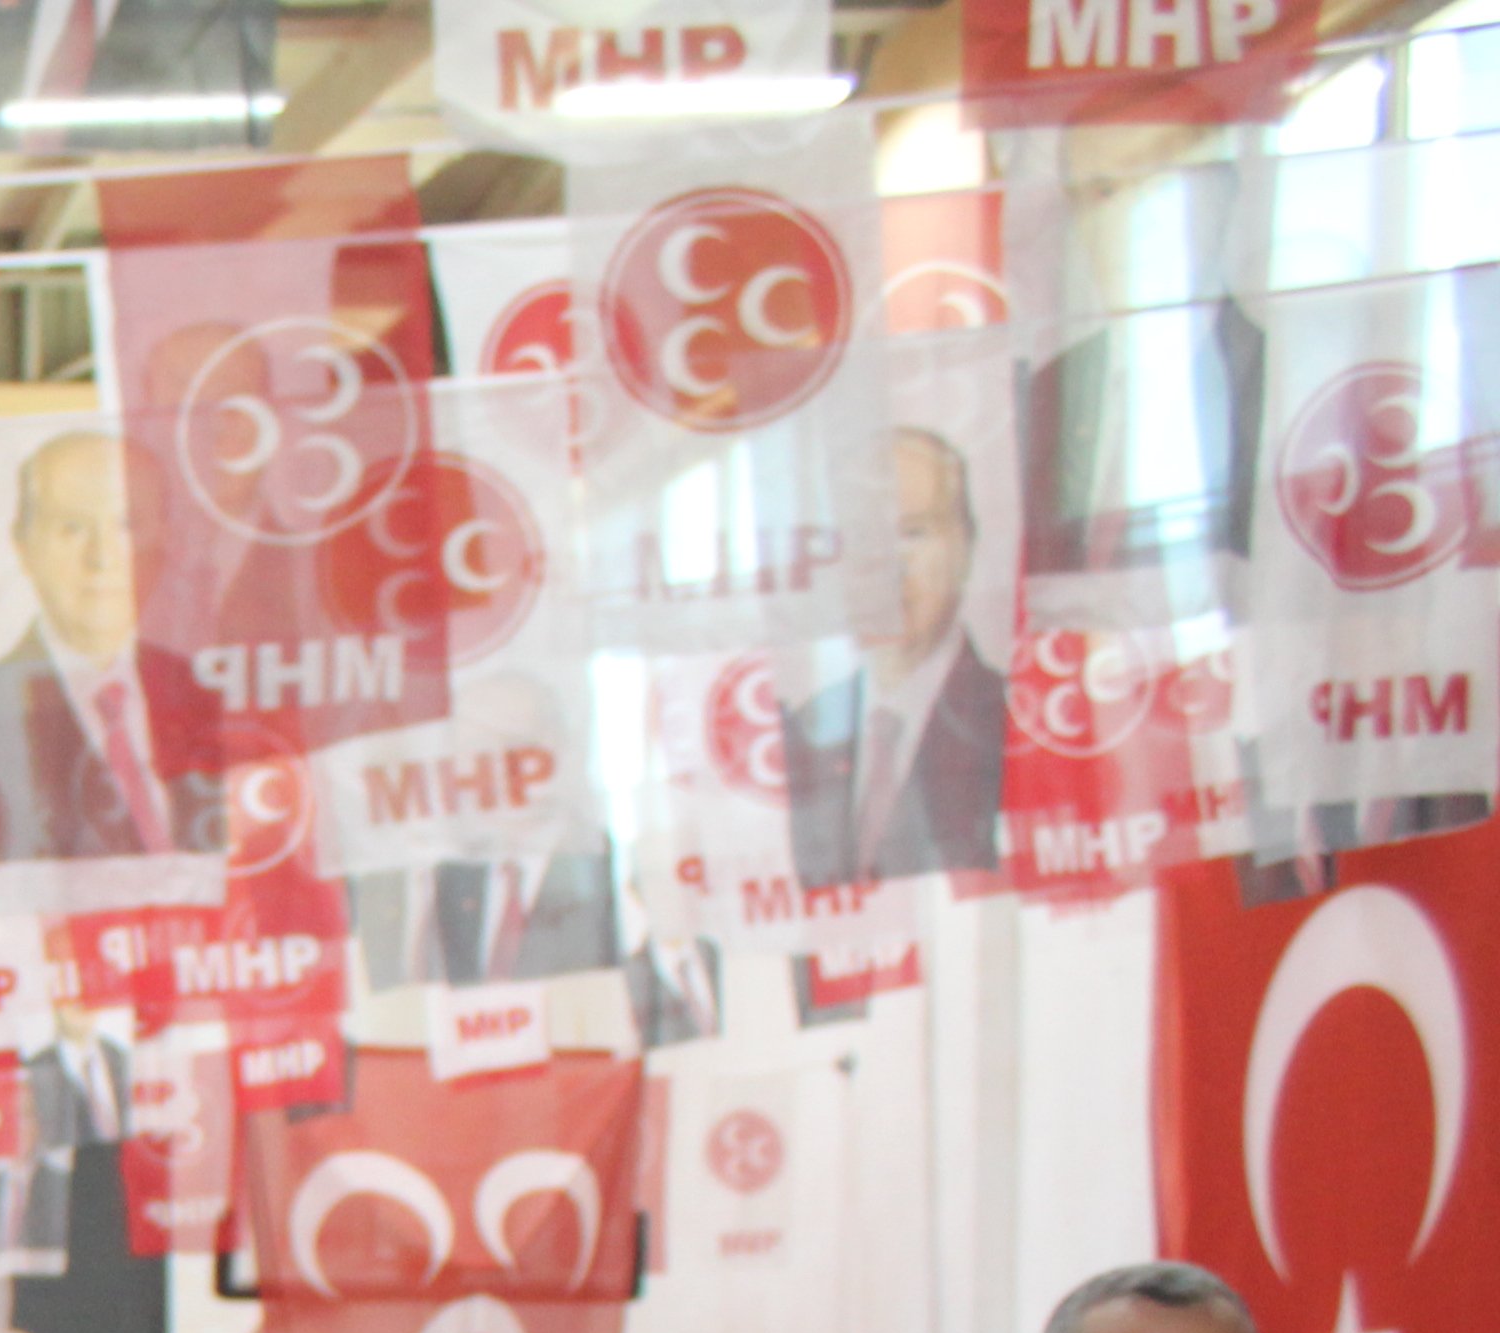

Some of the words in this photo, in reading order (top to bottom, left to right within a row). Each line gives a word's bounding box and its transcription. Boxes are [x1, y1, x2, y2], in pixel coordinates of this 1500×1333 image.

[1027, 0, 1282, 69] MHP
[497, 26, 747, 112] MHP
[362, 747, 555, 826] MHP
[1033, 811, 1168, 875] MHP
[175, 934, 320, 995] MHP
[456, 1007, 532, 1044] MHP
[239, 1040, 326, 1087] MHP
